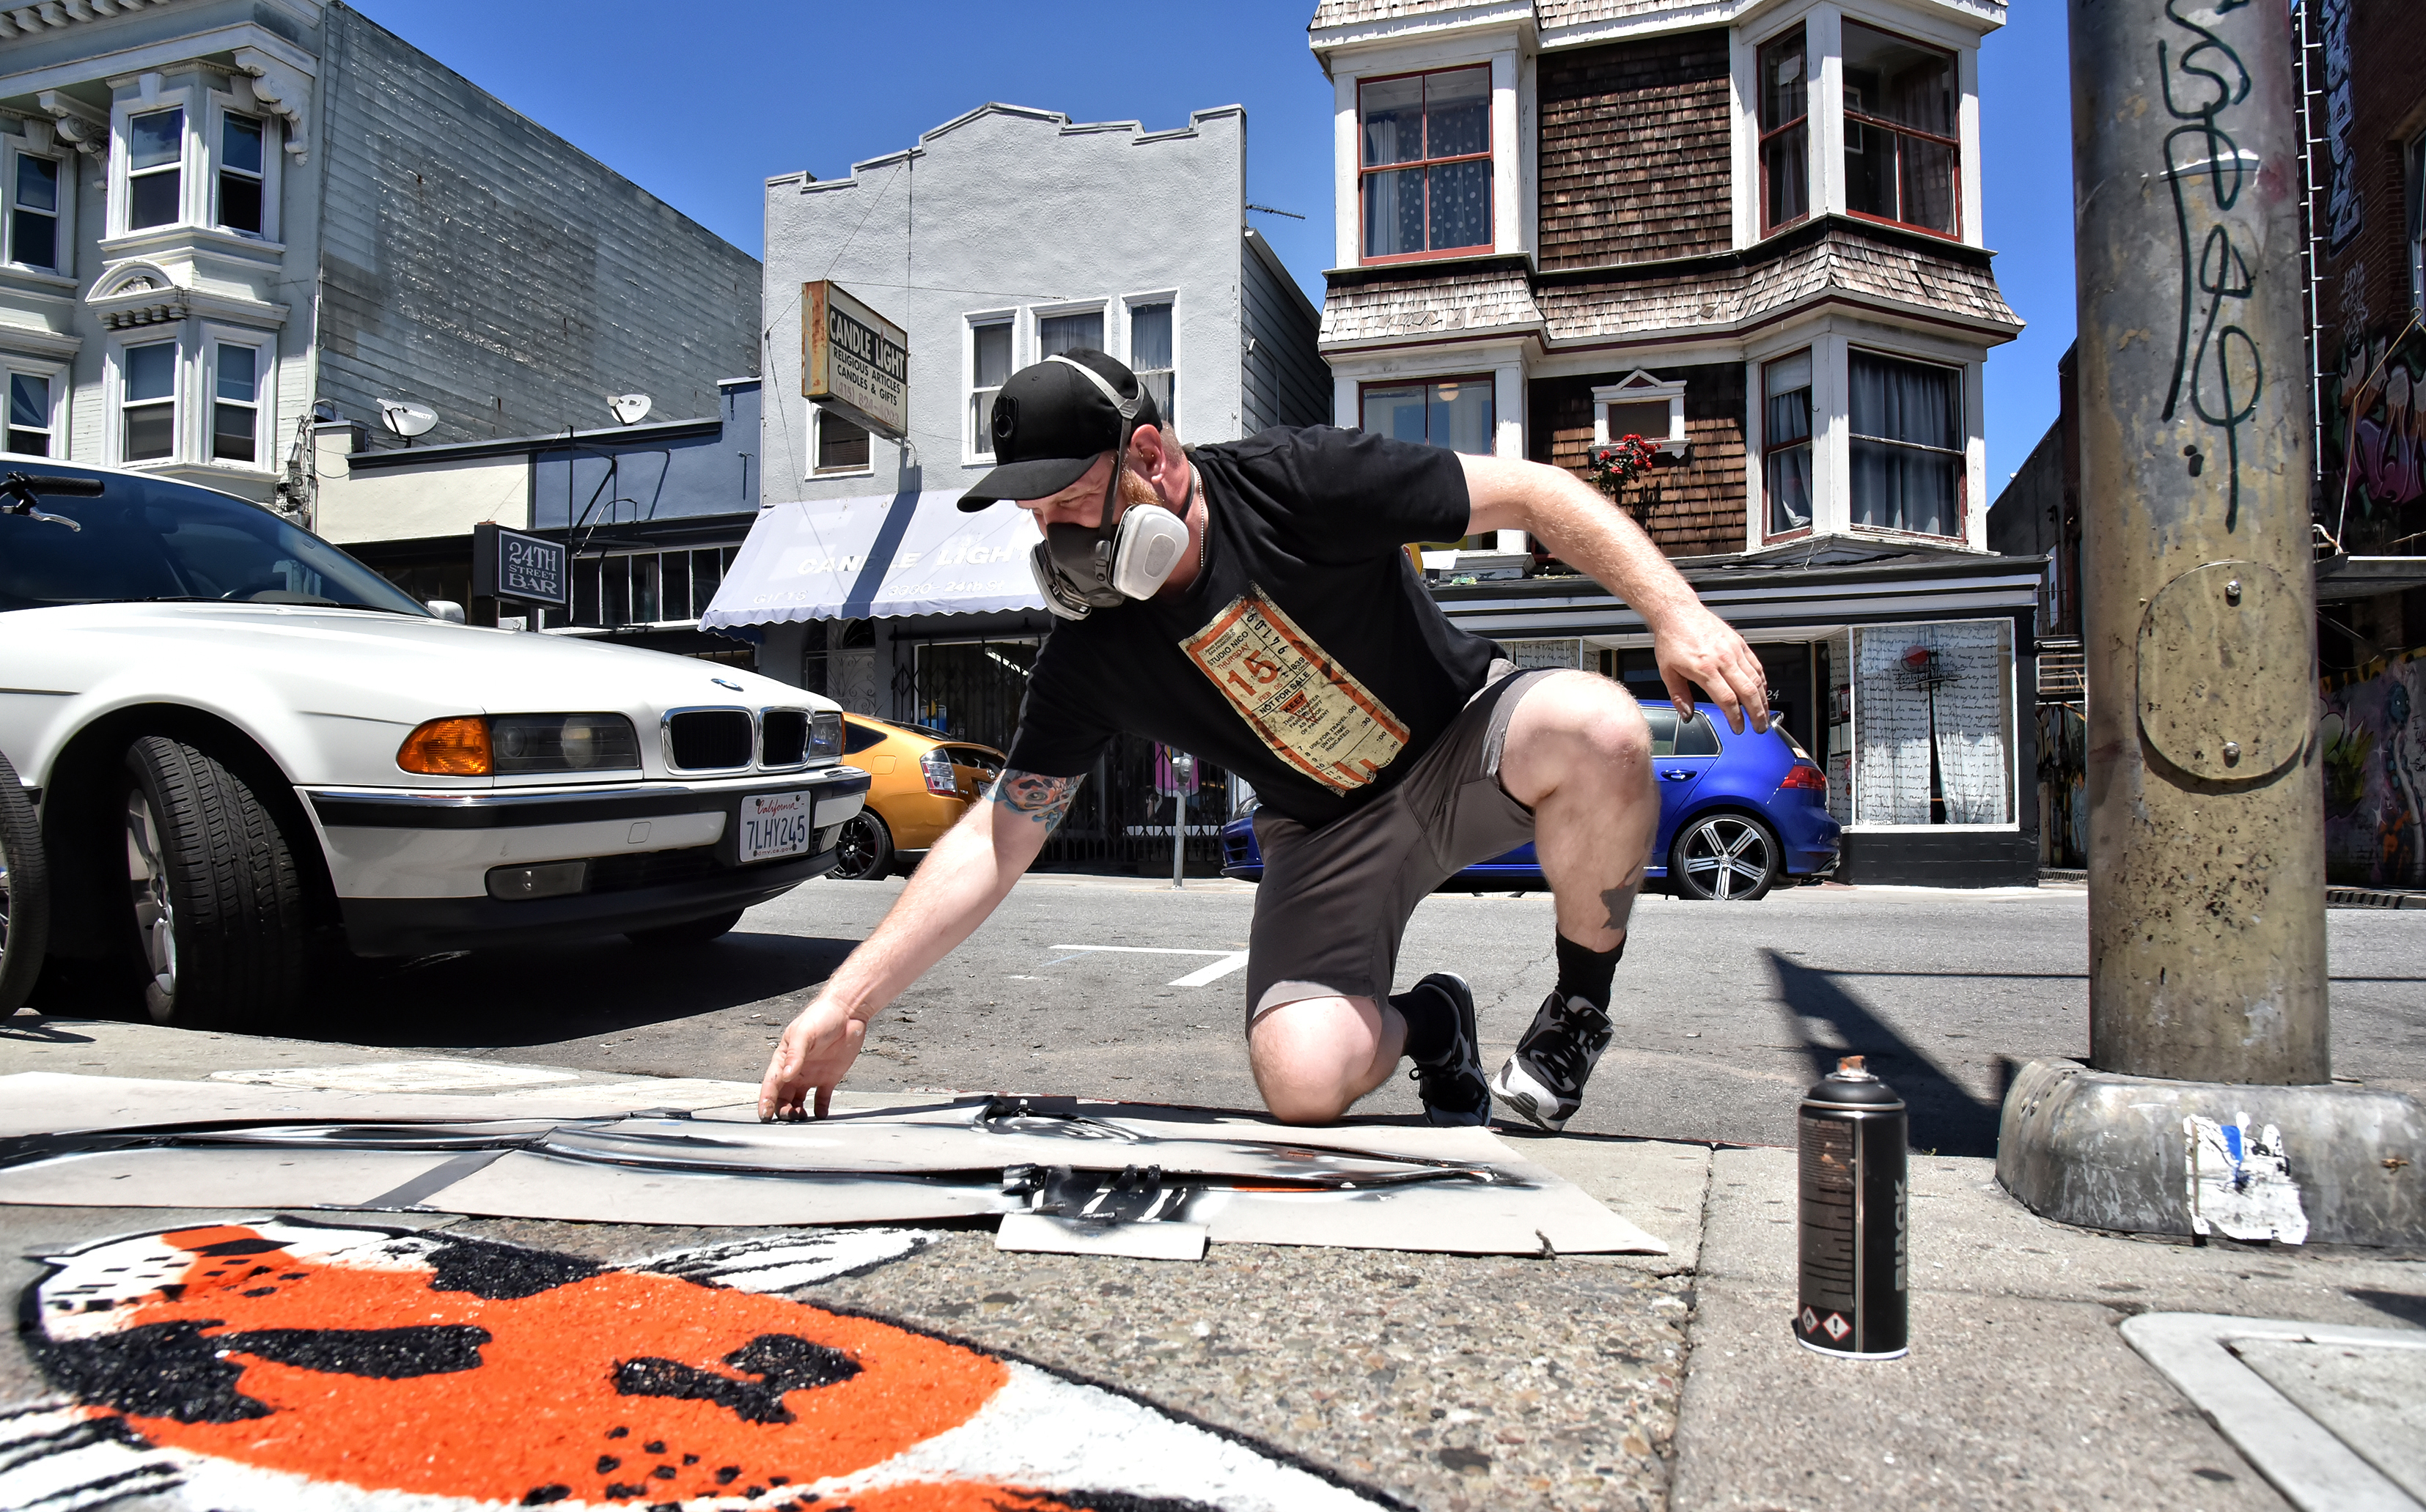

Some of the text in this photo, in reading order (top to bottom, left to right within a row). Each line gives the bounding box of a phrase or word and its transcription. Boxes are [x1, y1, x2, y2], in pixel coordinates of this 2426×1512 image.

[830, 311, 905, 380] CANDLE LIGHT
[834, 346, 900, 394] RELIGIOUS ARTICLES
[836, 378, 855, 403] (415)
[837, 364, 897, 406] CANDLES & GIFTS
[509, 542, 556, 572] 24TH
[935, 546, 1030, 567] LIGHT
[509, 564, 556, 580] STREET
[509, 572, 556, 594] BAR
[1207, 630, 1249, 666] STUDIO NICO
[1215, 633, 1229, 646] PRINTED
[1216, 632, 1235, 648] FRANCISCO
[1217, 642, 1250, 671] THURSDAY
[1290, 657, 1305, 671] 839
[1227, 649, 1279, 696] 15
[1257, 682, 1283, 703] FEB 05
[1259, 671, 1310, 715] NOT FOR SALE
[1282, 693, 1305, 713] KEEP
[1283, 694, 1320, 726] THIS TRANSFER
[1290, 700, 1323, 729] FARE RECEIPT
[1308, 709, 1330, 729] PAYMENT
[1347, 705, 1357, 716] :00
[1309, 715, 1348, 750] USE FOR TRAVEL
[1360, 717, 1371, 729] :30
[1320, 725, 1347, 749] UNTIL TIME
[1325, 729, 1350, 752] INDICATED
[1376, 731, 1387, 742] :00
[1389, 740, 1398, 751] :30
[757, 799, 798, 817] California
[747, 815, 805, 850] 7LHY245
[757, 847, 793, 856] dmv.ca.gov
[1895, 1179, 1905, 1291] BLACK
